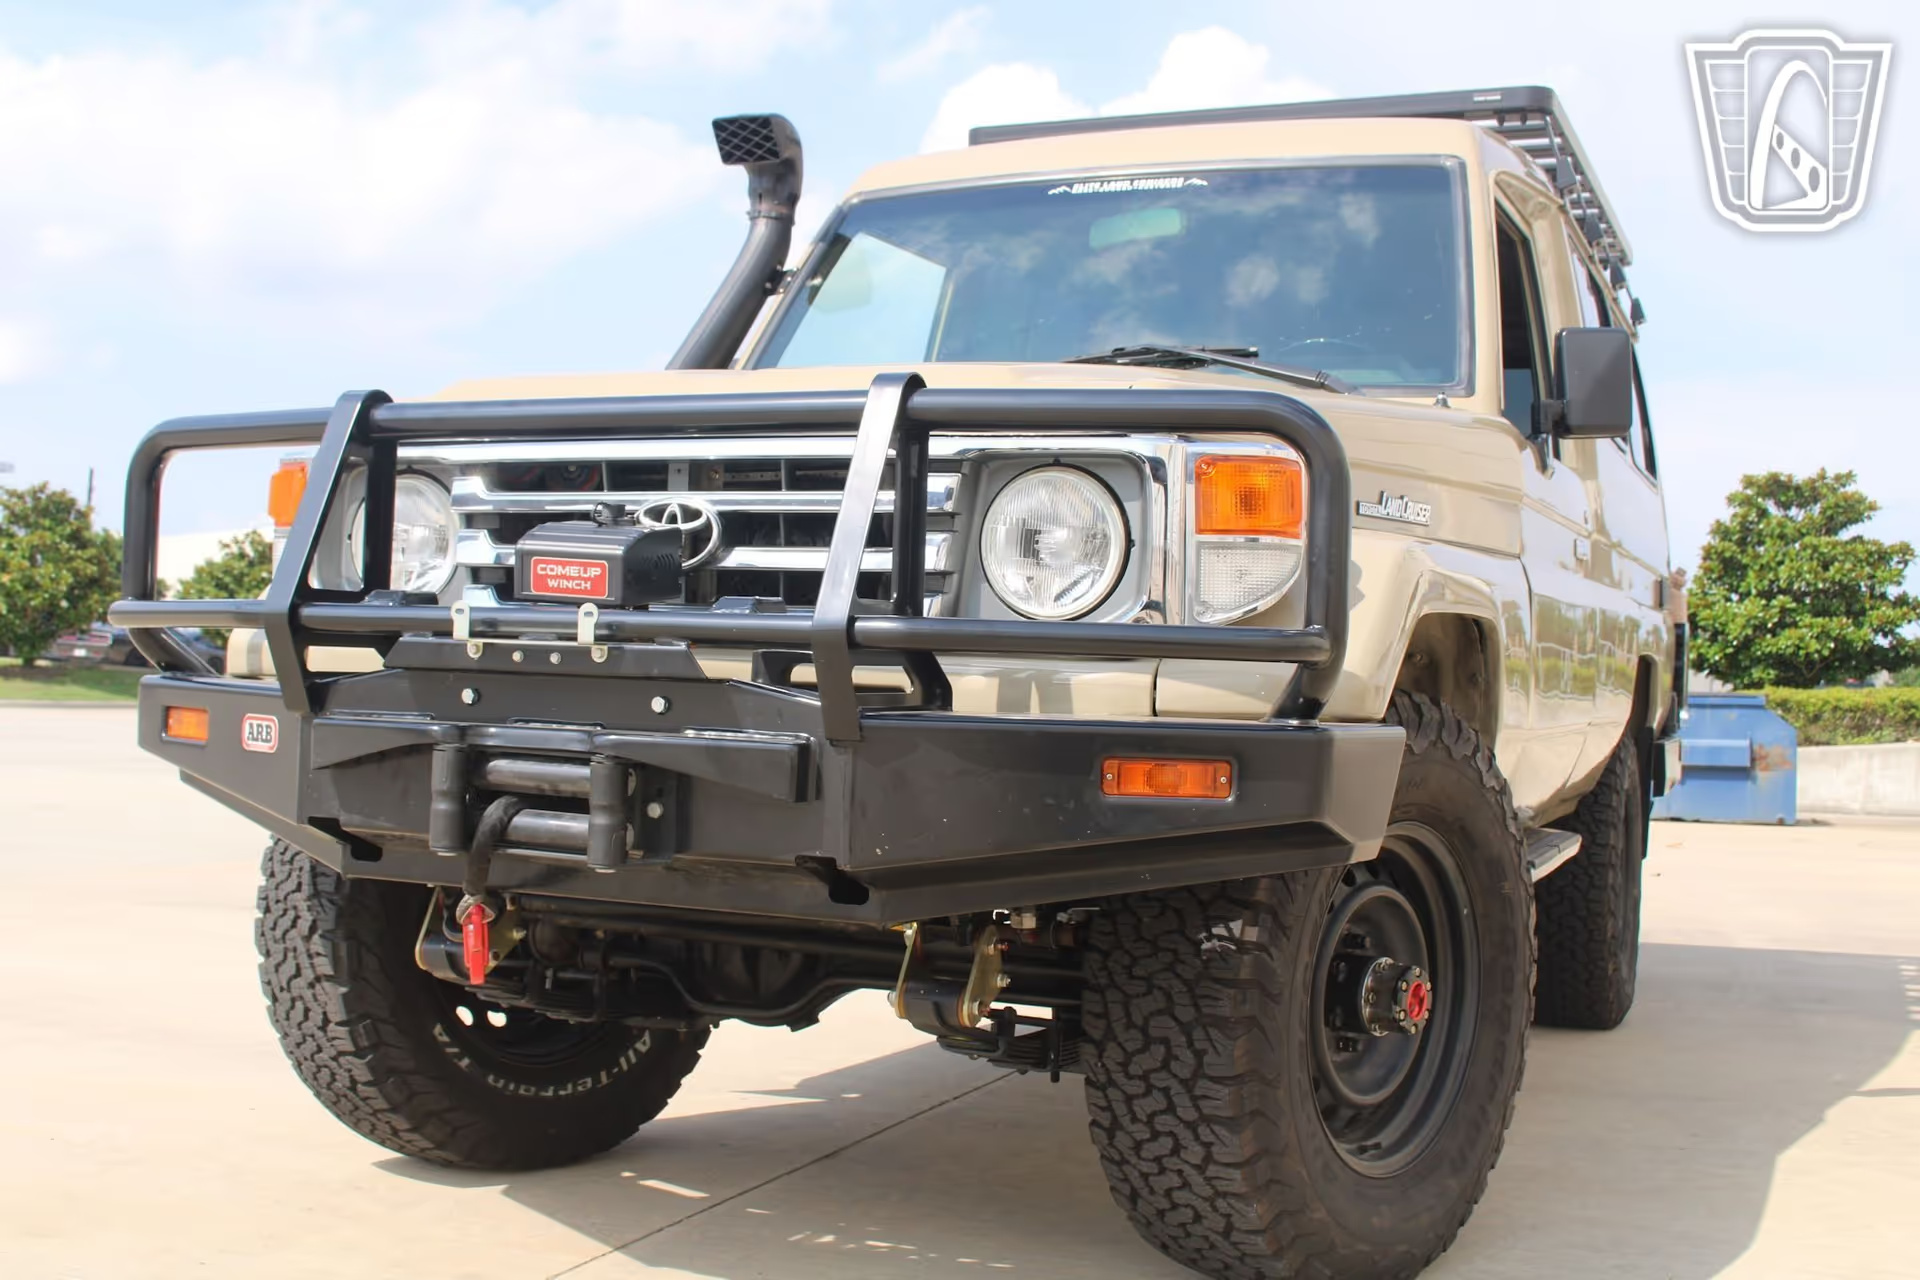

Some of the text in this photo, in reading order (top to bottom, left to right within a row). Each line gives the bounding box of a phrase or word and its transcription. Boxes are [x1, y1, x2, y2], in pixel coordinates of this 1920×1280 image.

[537, 564, 602, 578] COMEUP
[547, 578, 592, 590] WINCH
[247, 722, 273, 744] ARB
